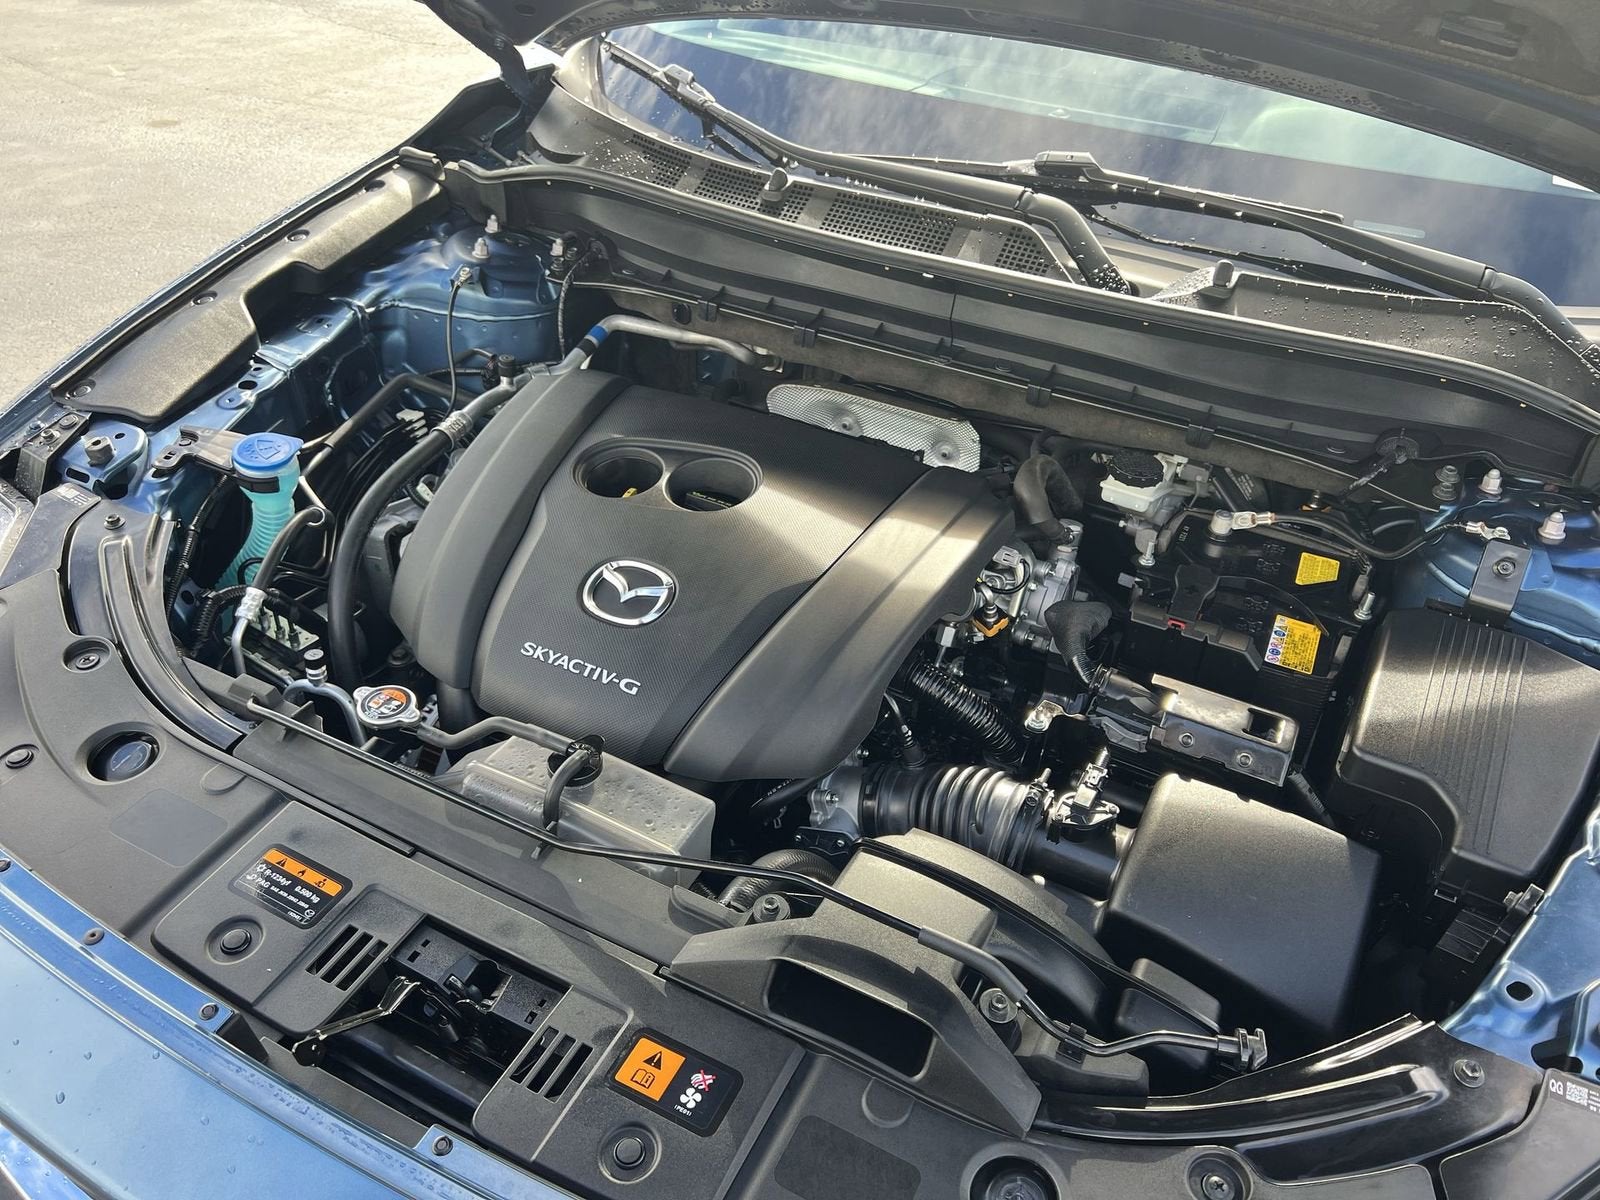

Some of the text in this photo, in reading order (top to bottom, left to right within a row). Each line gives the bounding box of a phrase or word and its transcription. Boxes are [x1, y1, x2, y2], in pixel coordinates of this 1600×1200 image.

[520, 641, 641, 696] SKYACTIV-G
[255, 877, 270, 888] PAG
[264, 869, 292, 886] R-1234yf
[310, 893, 320, 903] kg
[1549, 1078, 1564, 1096] QG
